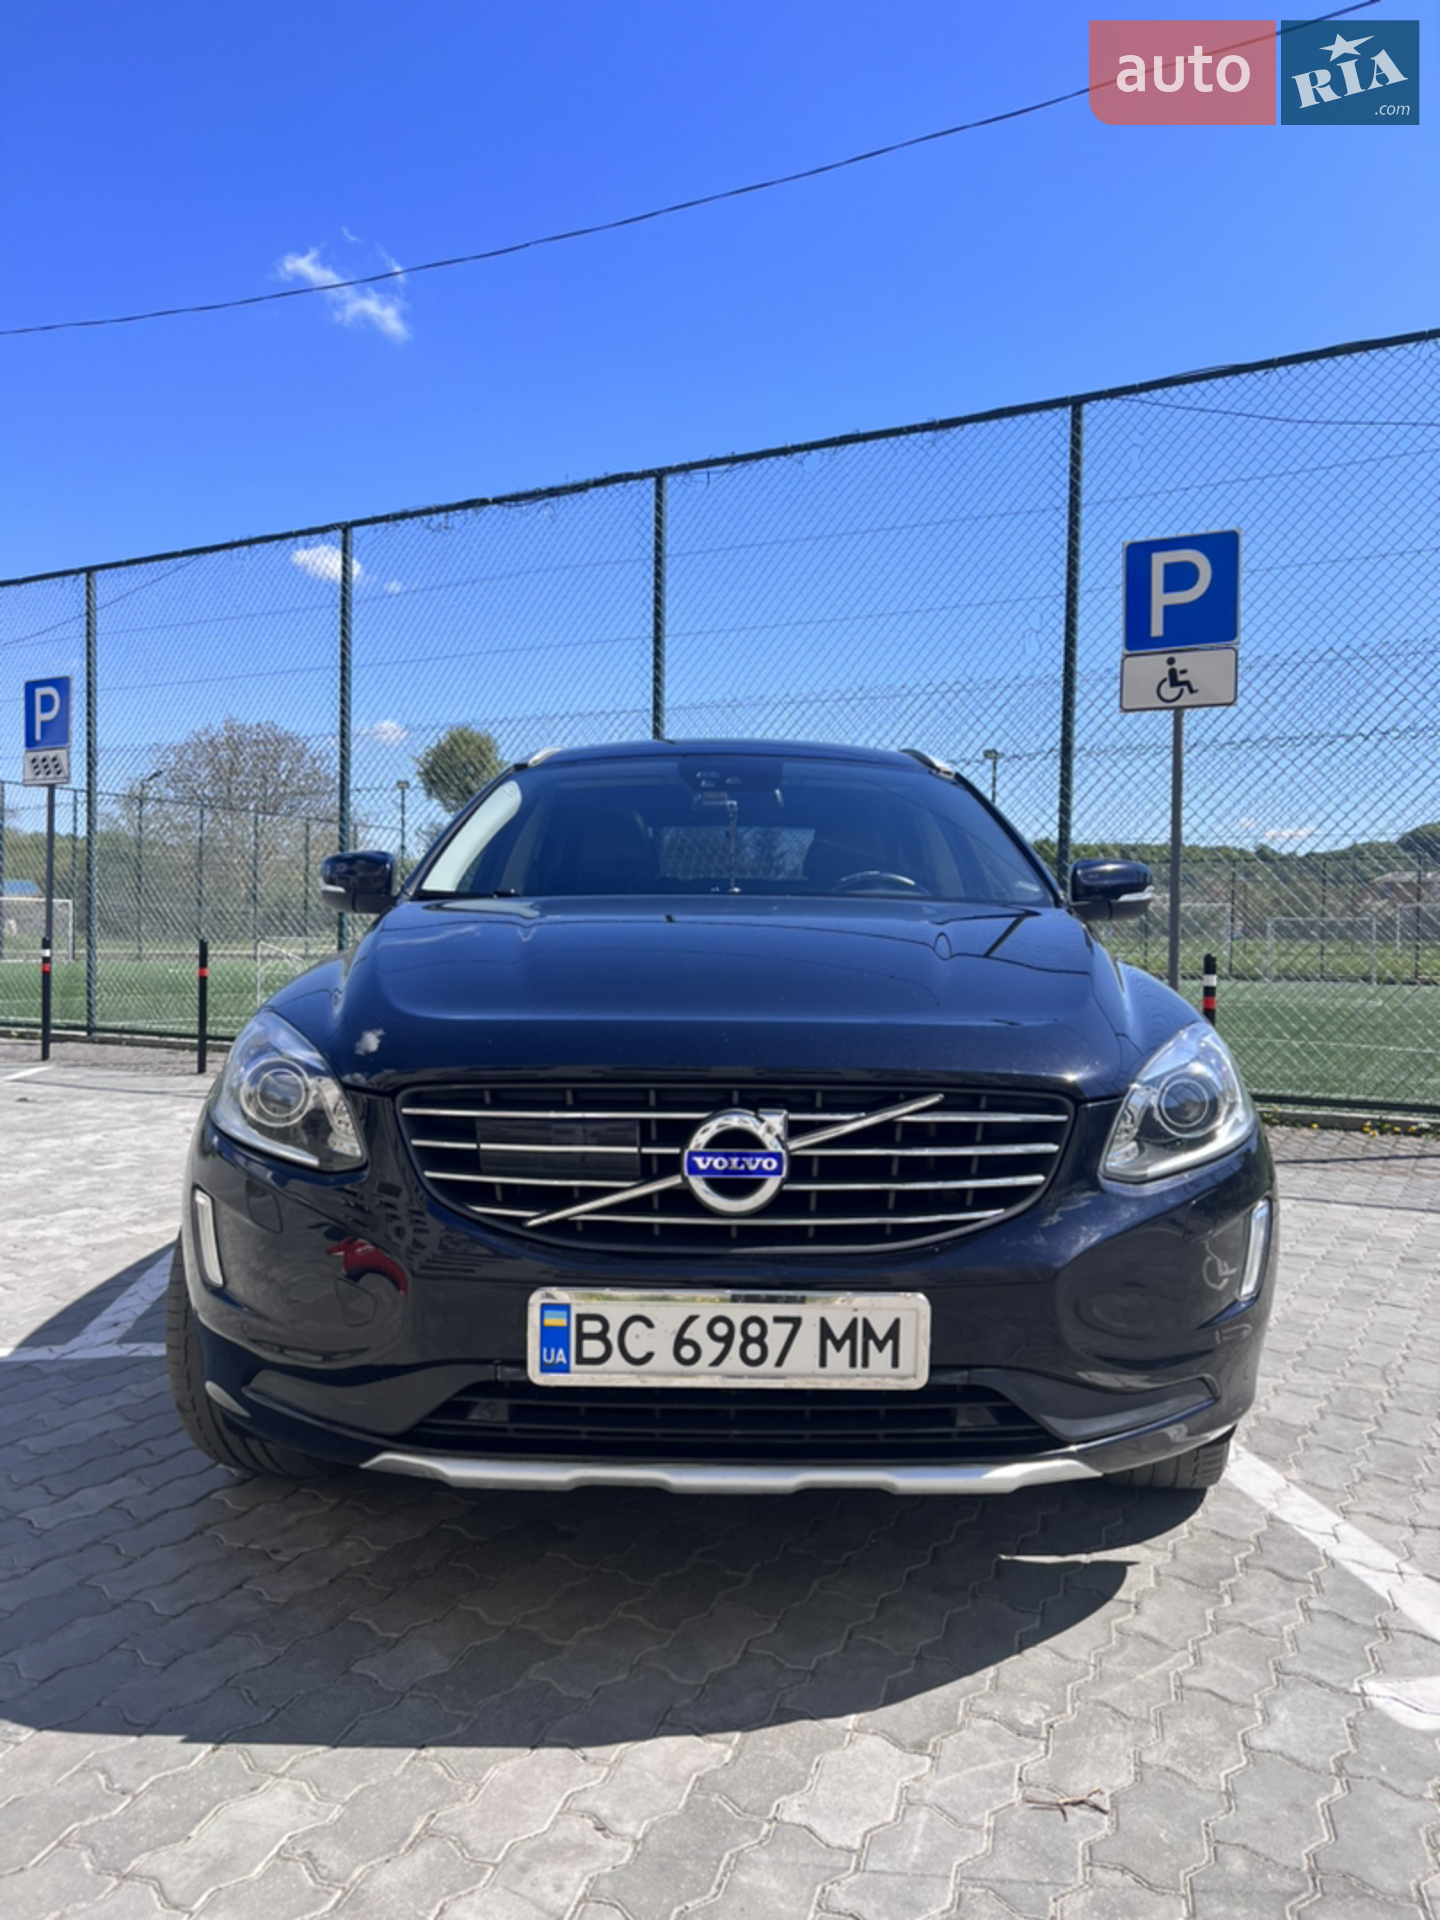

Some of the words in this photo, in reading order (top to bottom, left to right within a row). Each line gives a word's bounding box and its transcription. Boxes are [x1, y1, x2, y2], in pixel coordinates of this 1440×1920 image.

[1151, 549, 1213, 637] P
[35, 686, 61, 741] P
[692, 1156, 778, 1171] VOLVO
[543, 1348, 567, 1365] UA
[575, 1313, 655, 1366] BC
[672, 1314, 803, 1368] 6987
[818, 1317, 901, 1369] MM
